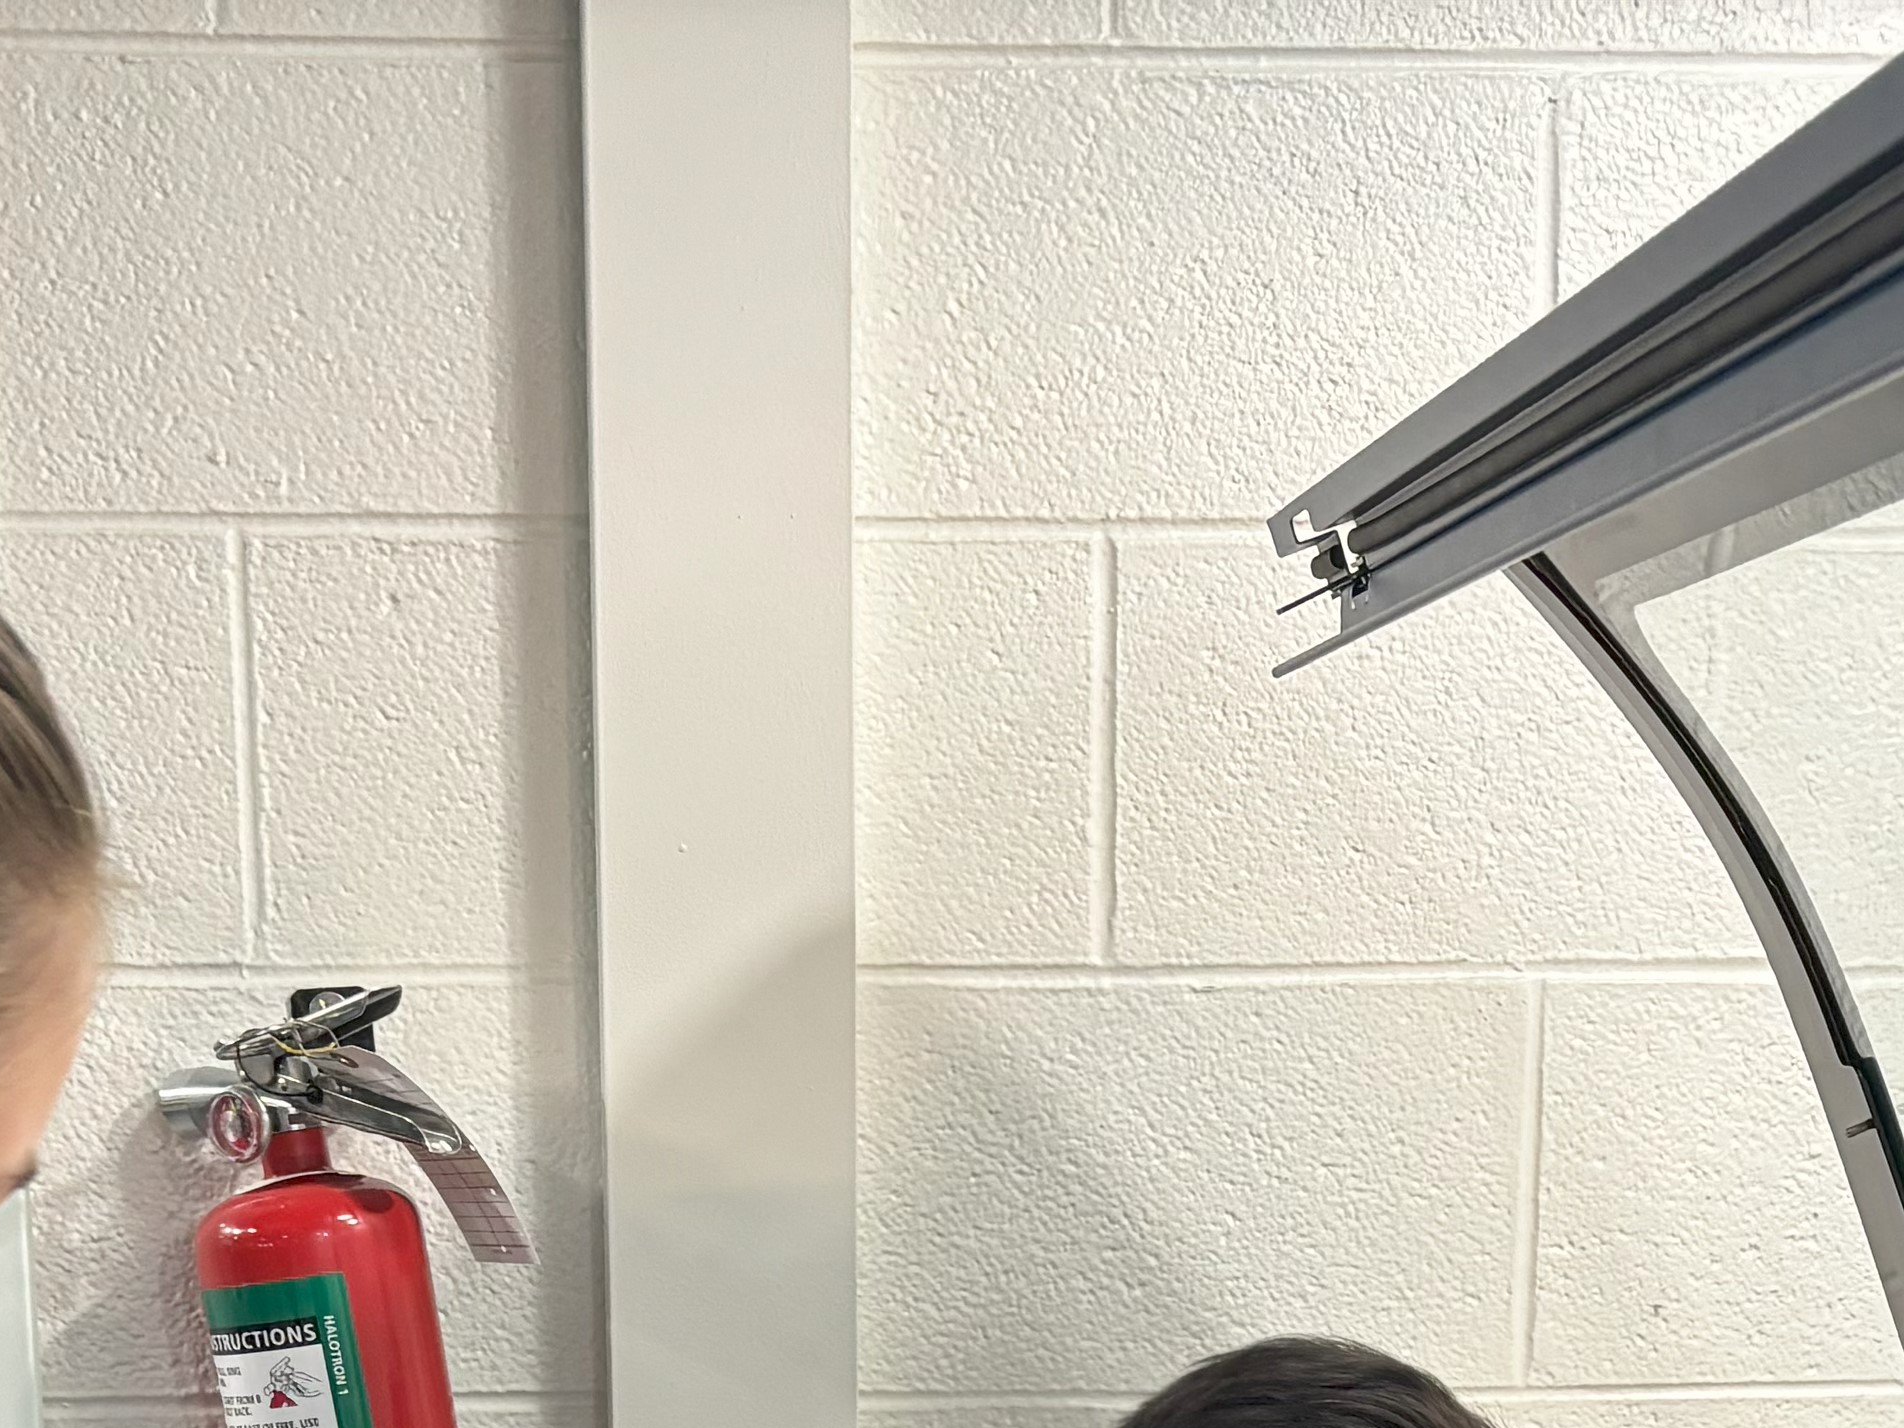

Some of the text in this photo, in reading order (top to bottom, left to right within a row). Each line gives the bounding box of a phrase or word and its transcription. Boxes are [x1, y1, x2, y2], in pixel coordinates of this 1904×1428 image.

[210, 1323, 317, 1352] STRUCTIONS
[323, 1315, 350, 1396] HALOTRON 1
